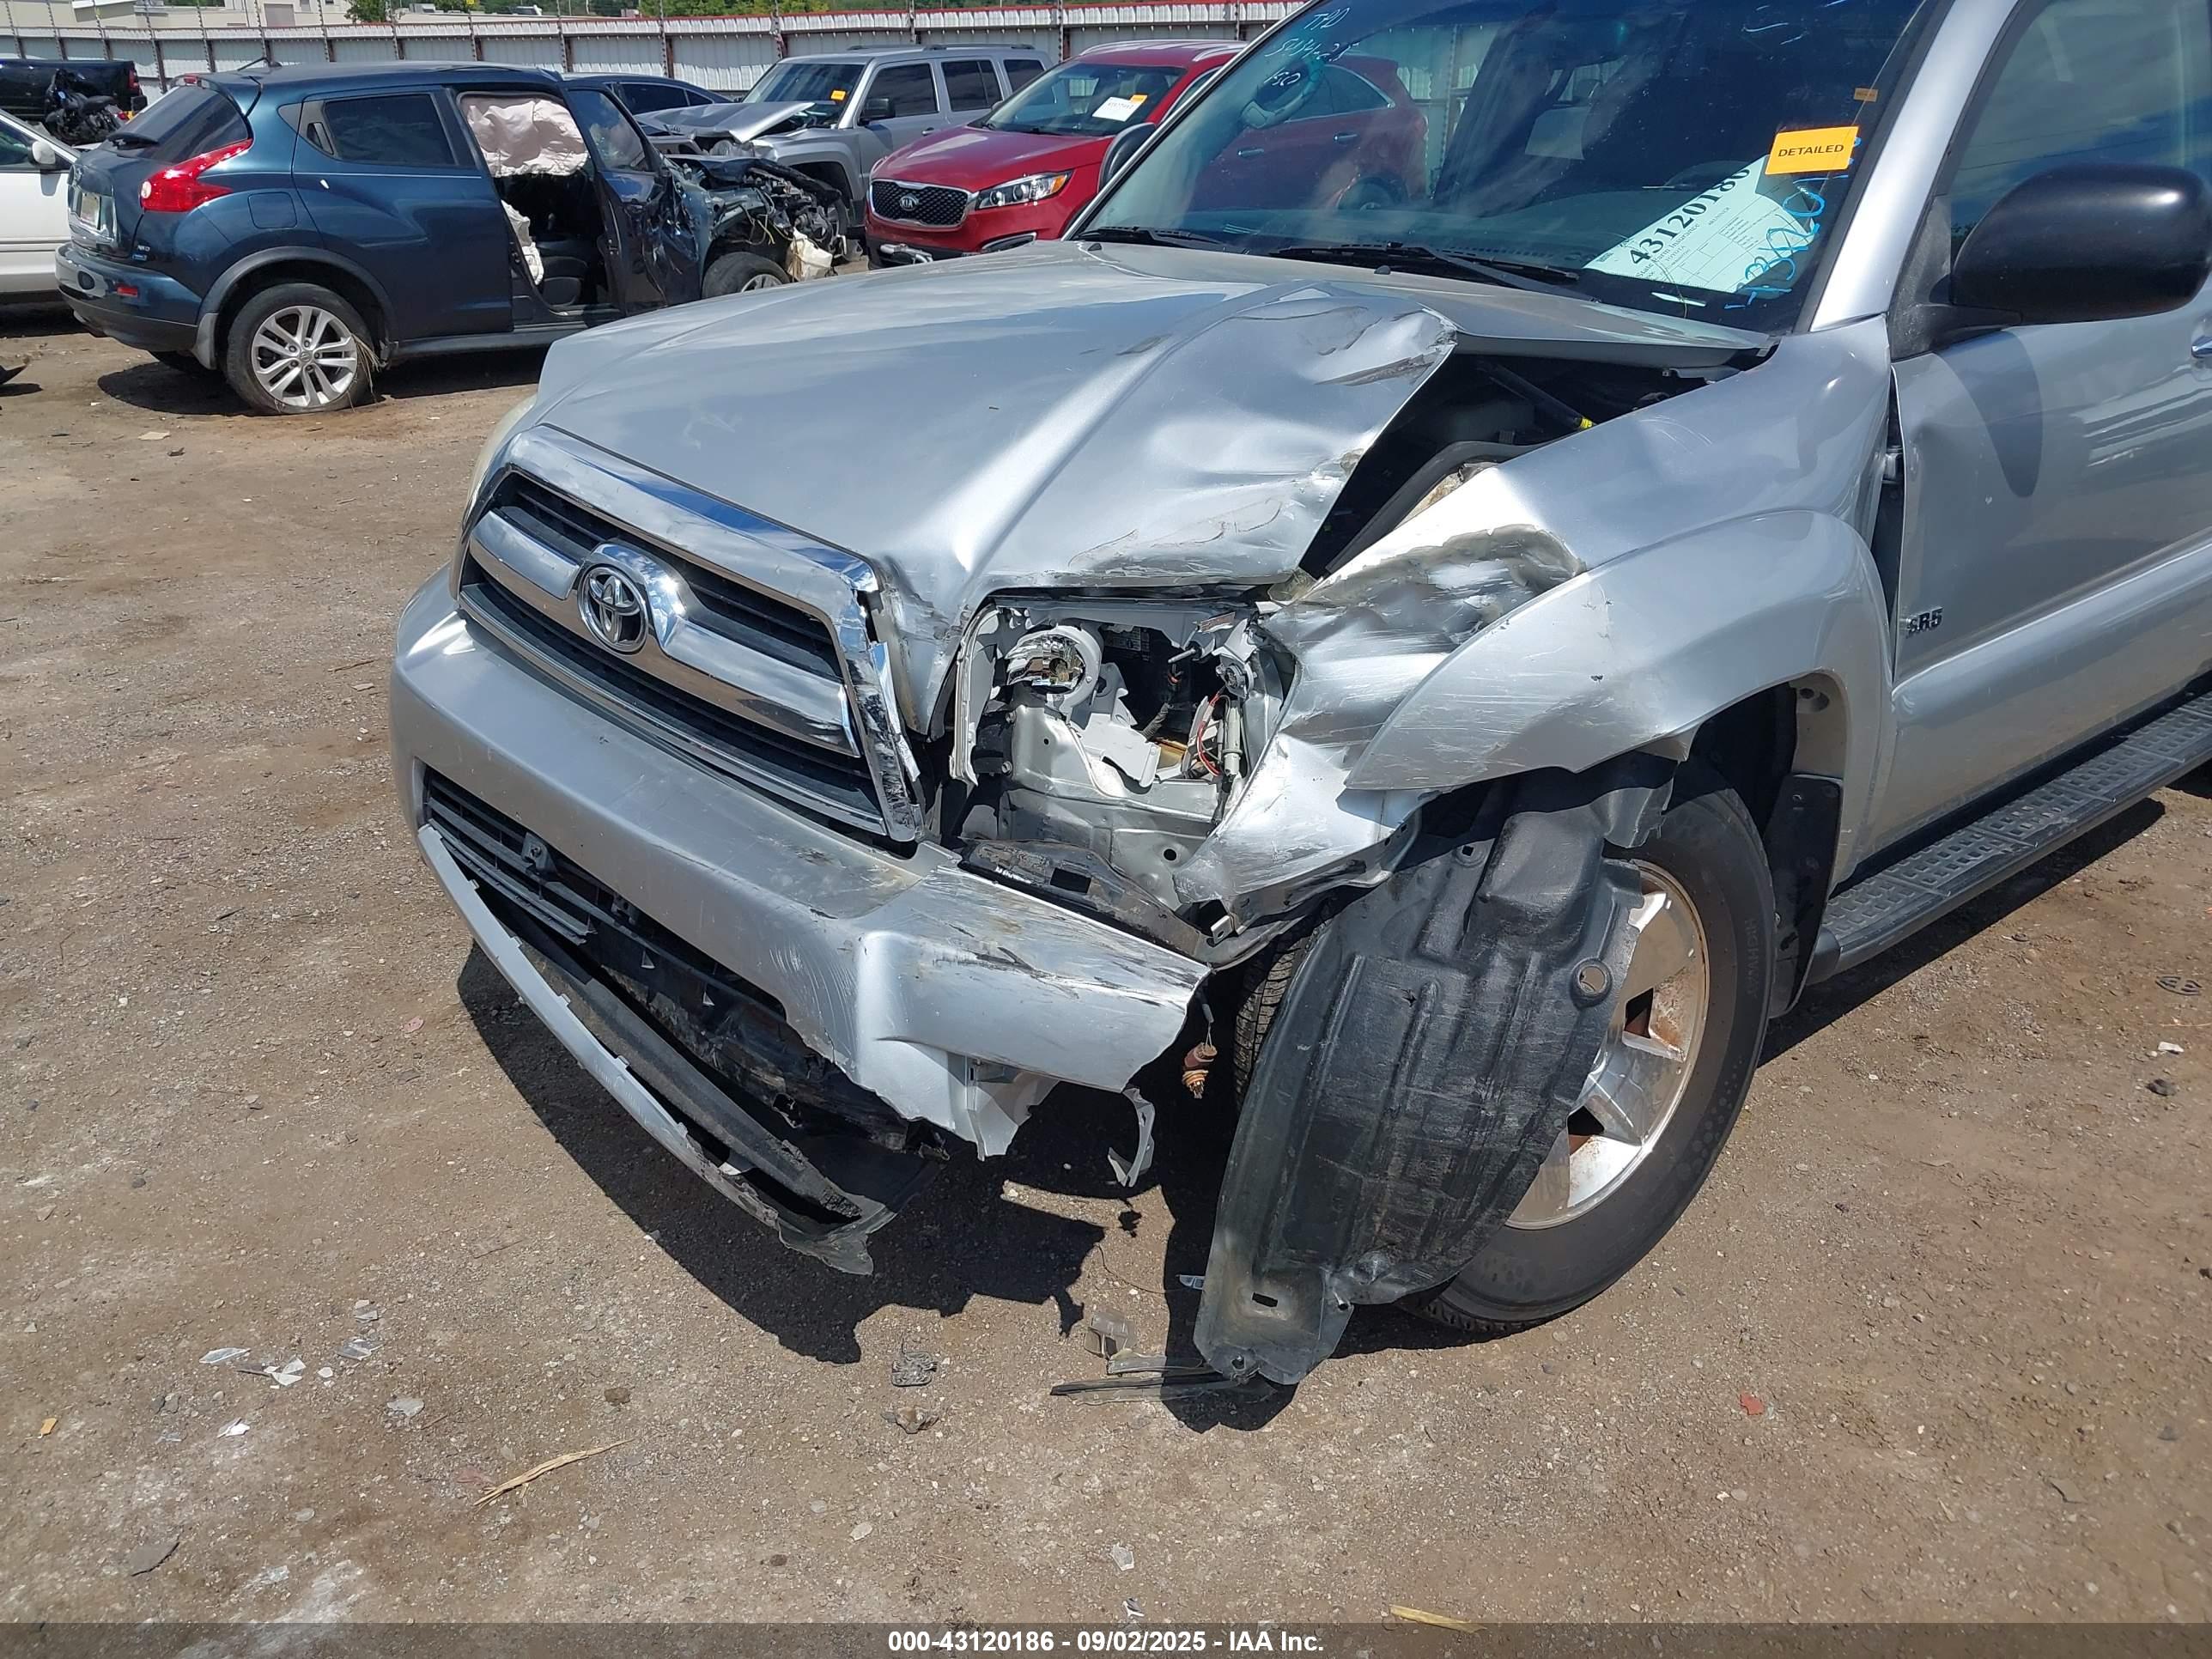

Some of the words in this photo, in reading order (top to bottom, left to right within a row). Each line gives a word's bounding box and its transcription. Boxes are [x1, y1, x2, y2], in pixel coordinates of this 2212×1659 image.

[1778, 143, 1844, 157] DETAILED
[1669, 223, 1700, 252] Insurance
[1907, 606, 1943, 631] SR5
